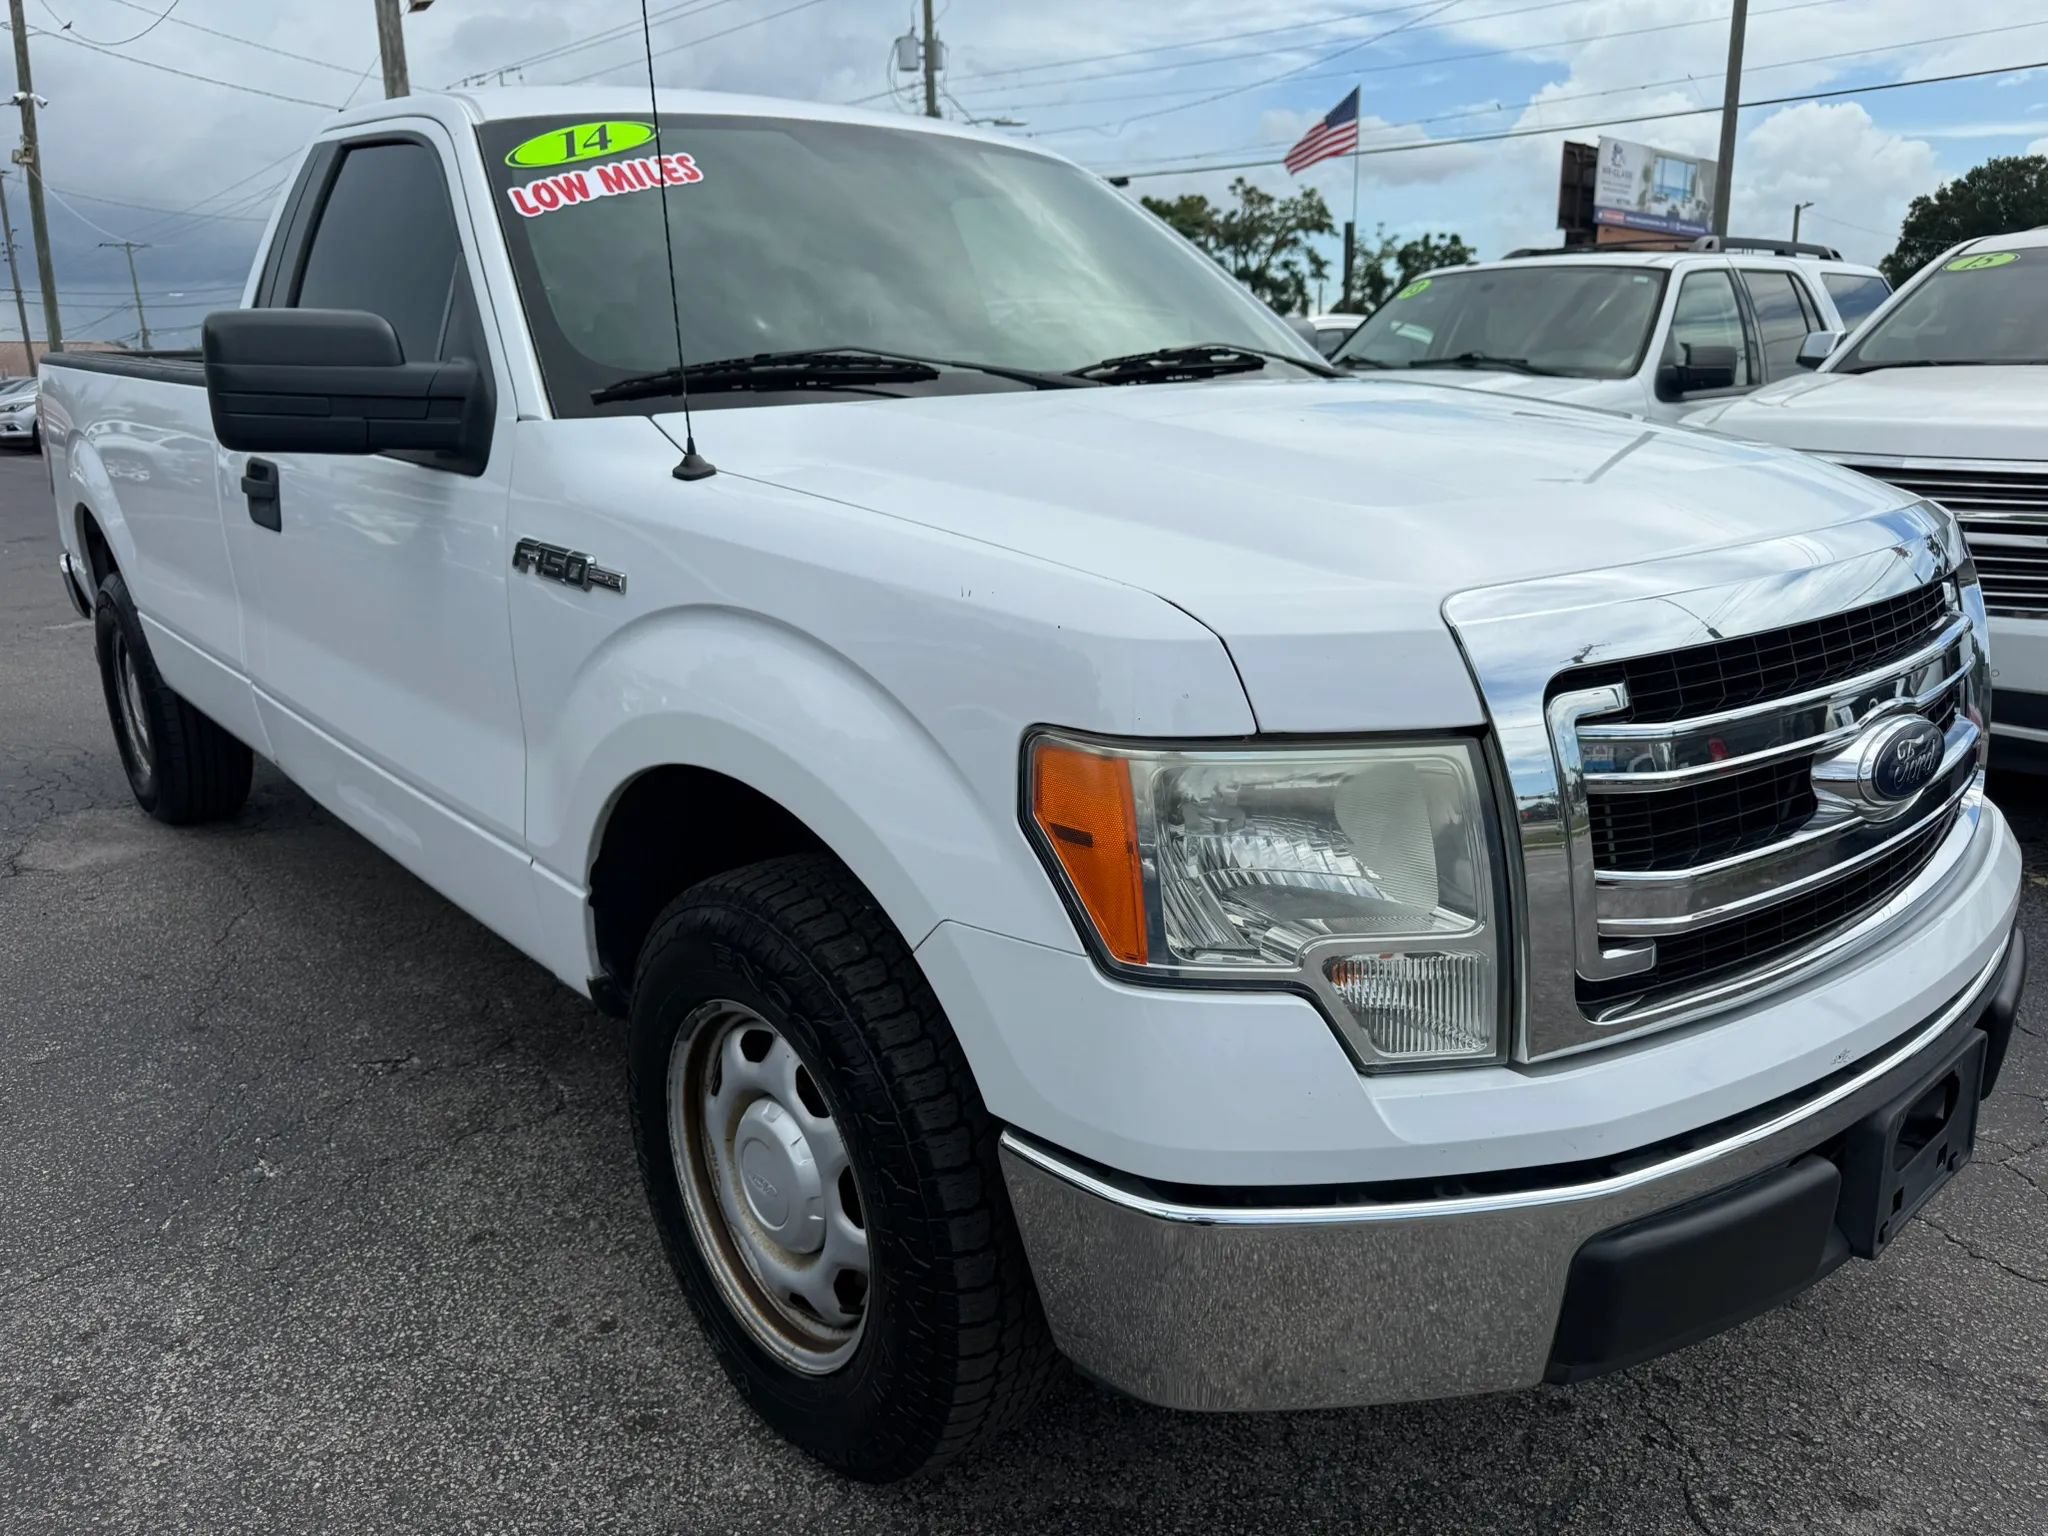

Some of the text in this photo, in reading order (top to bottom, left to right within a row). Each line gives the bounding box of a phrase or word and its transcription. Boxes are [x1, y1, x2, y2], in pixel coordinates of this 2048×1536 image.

[557, 124, 613, 161] 14
[512, 154, 702, 215] LOW MILES
[1893, 733, 1937, 790] Ford
